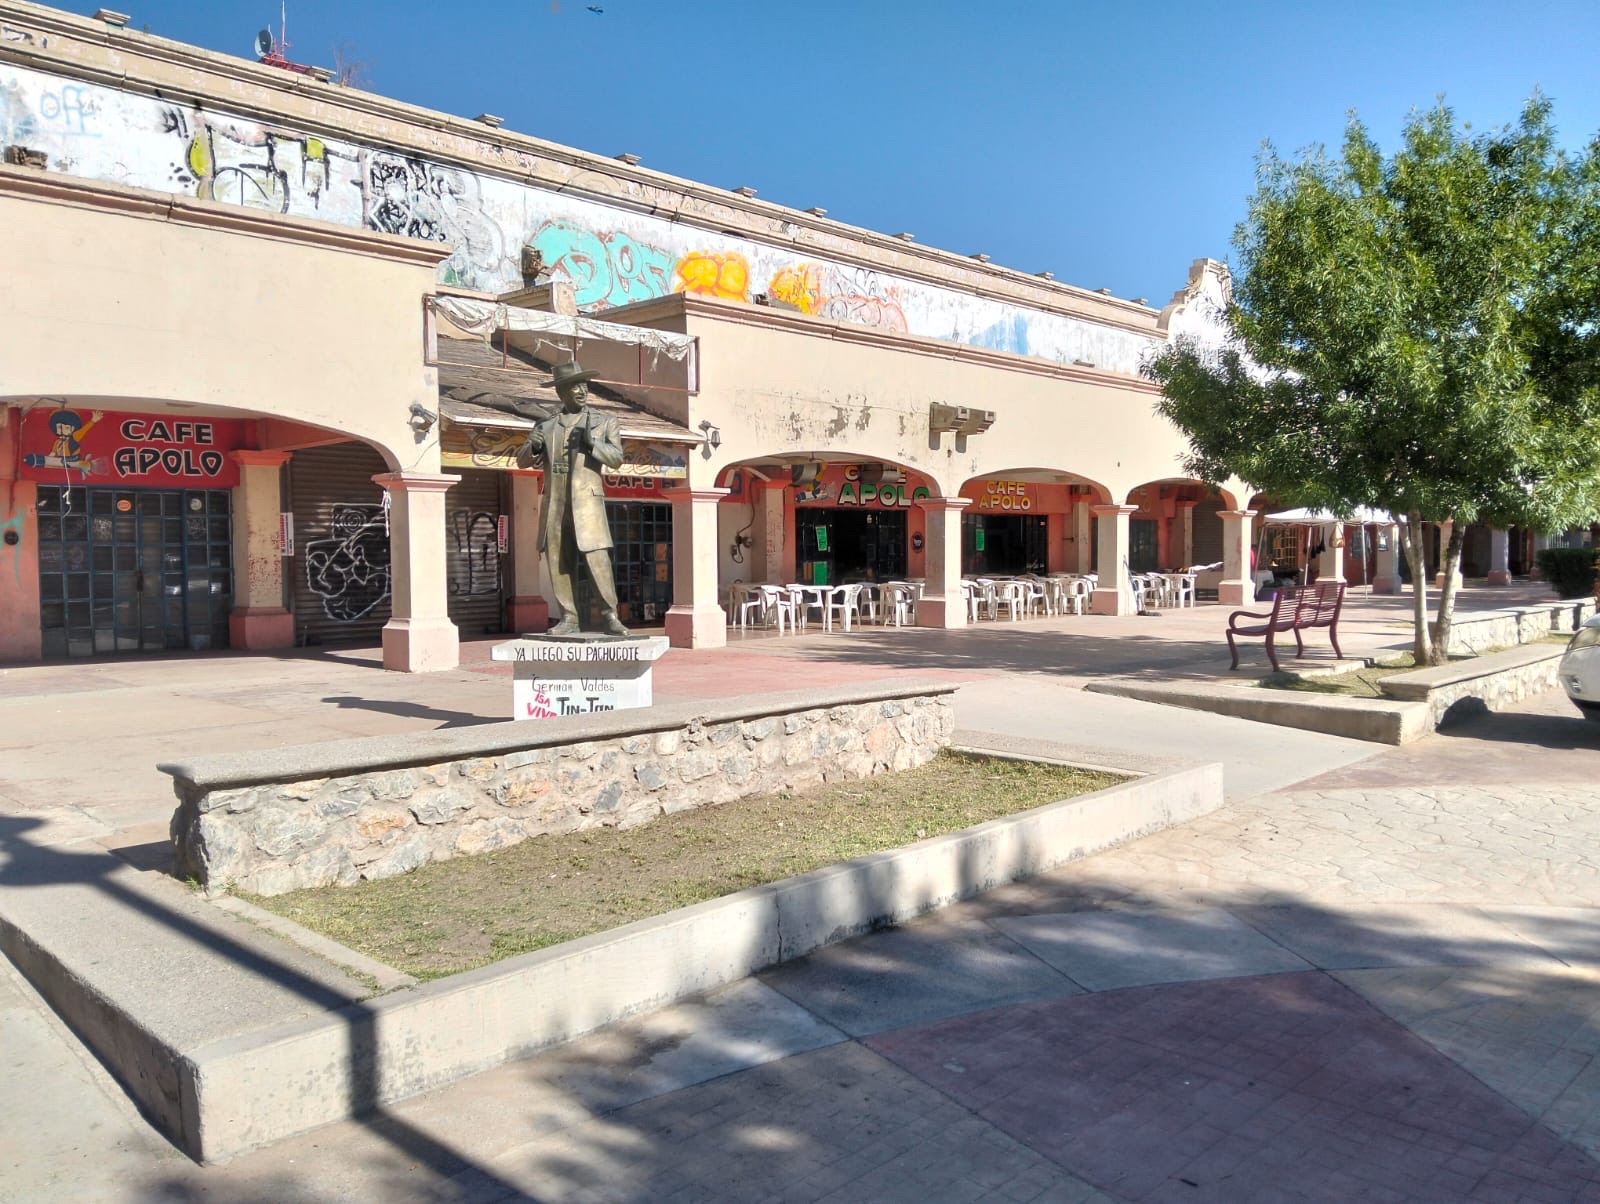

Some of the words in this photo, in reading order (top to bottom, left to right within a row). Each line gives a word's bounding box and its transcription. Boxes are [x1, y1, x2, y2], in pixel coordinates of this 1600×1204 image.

[120, 419, 213, 445] CAFE
[113, 446, 224, 478] APOLO
[986, 480, 1025, 496] CAFE
[979, 495, 1031, 511] APOLO
[514, 646, 526, 661] YA
[532, 646, 563, 661] LLEGO
[567, 646, 582, 661] SU
[586, 646, 639, 661] PACHUCOTE
